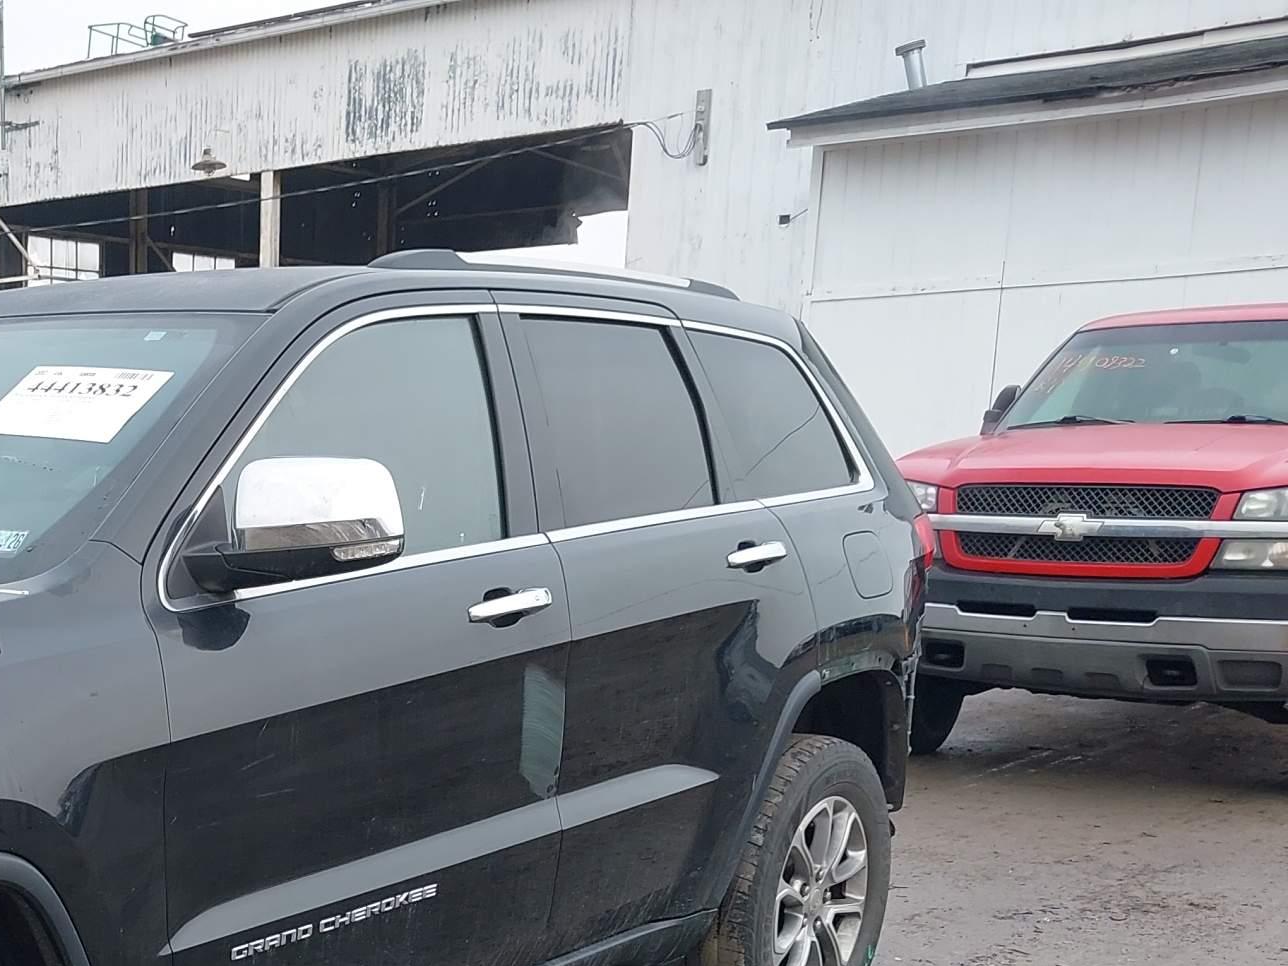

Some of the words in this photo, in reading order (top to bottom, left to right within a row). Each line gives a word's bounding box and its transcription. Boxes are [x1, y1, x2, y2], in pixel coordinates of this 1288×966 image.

[27, 380, 138, 397] 44413832
[231, 923, 313, 961] GRAND
[319, 883, 438, 933] CHEROKEE
